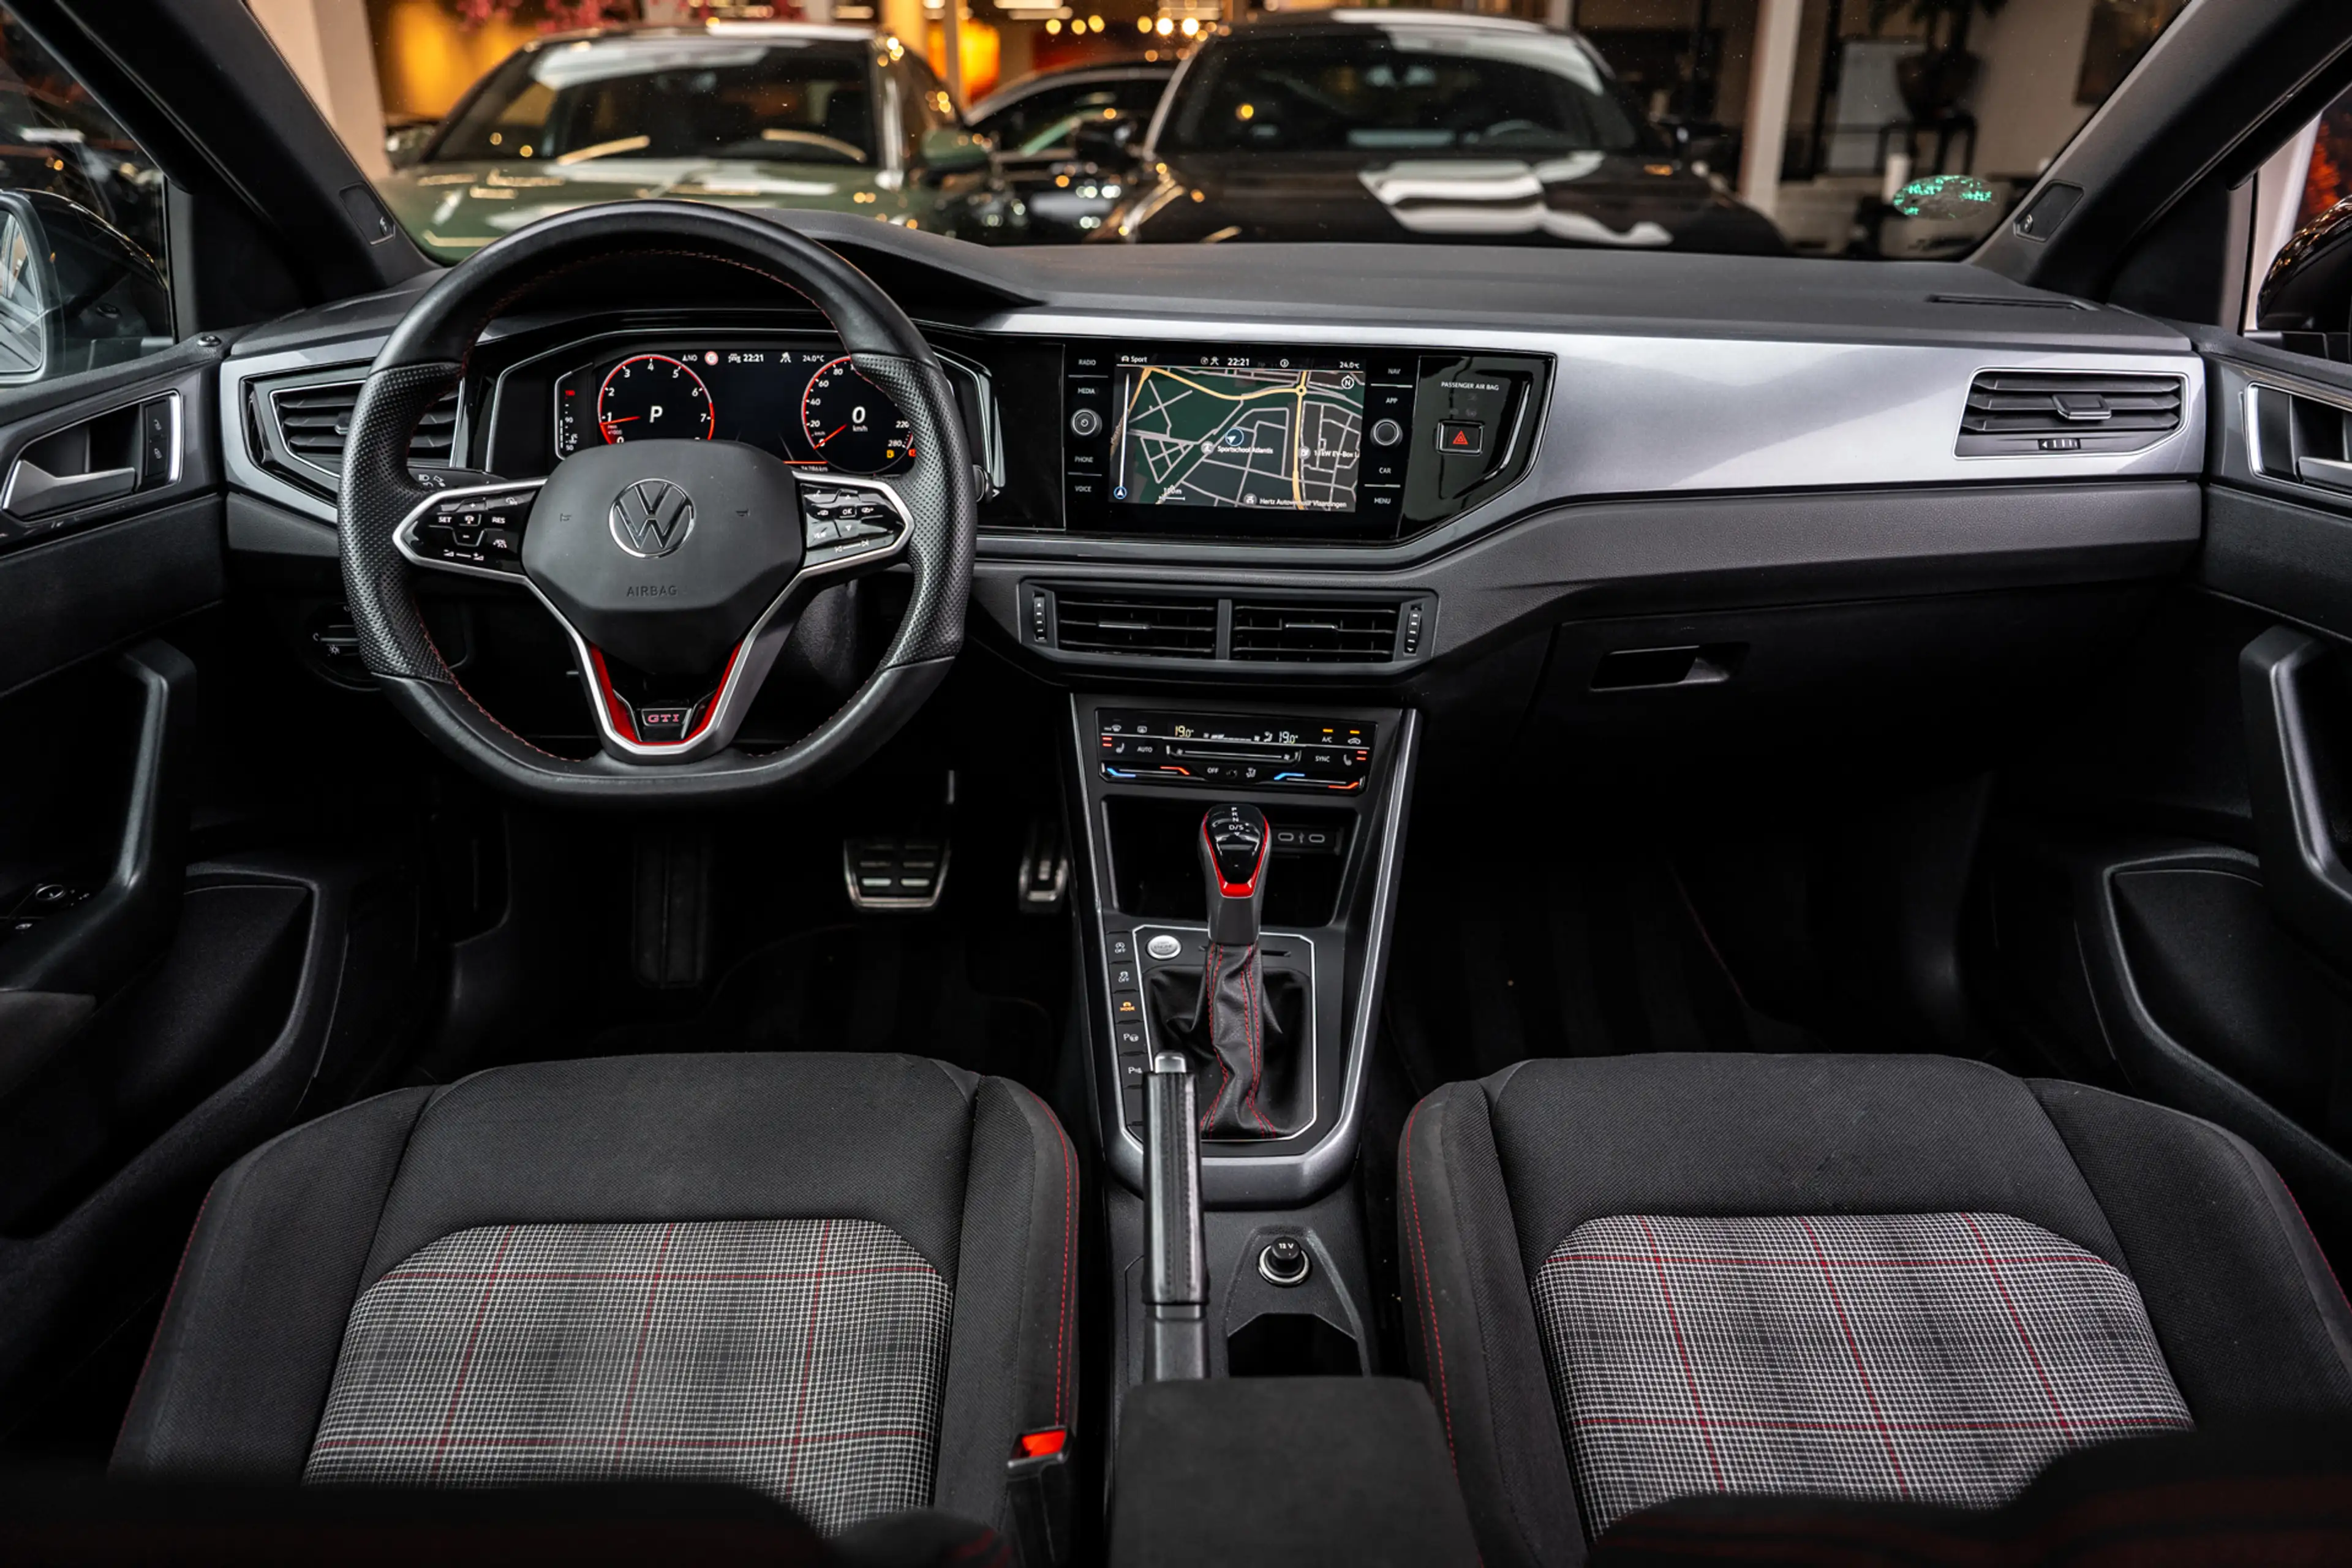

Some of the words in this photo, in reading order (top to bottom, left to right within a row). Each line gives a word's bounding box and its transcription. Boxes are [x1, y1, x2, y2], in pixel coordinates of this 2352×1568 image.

[608, 388, 614, 396] 2
[607, 412, 612, 423] 1
[650, 405, 663, 423] P
[852, 406, 866, 424] 0
[627, 586, 678, 597] AIRBAG
[647, 714, 679, 723] GTI
